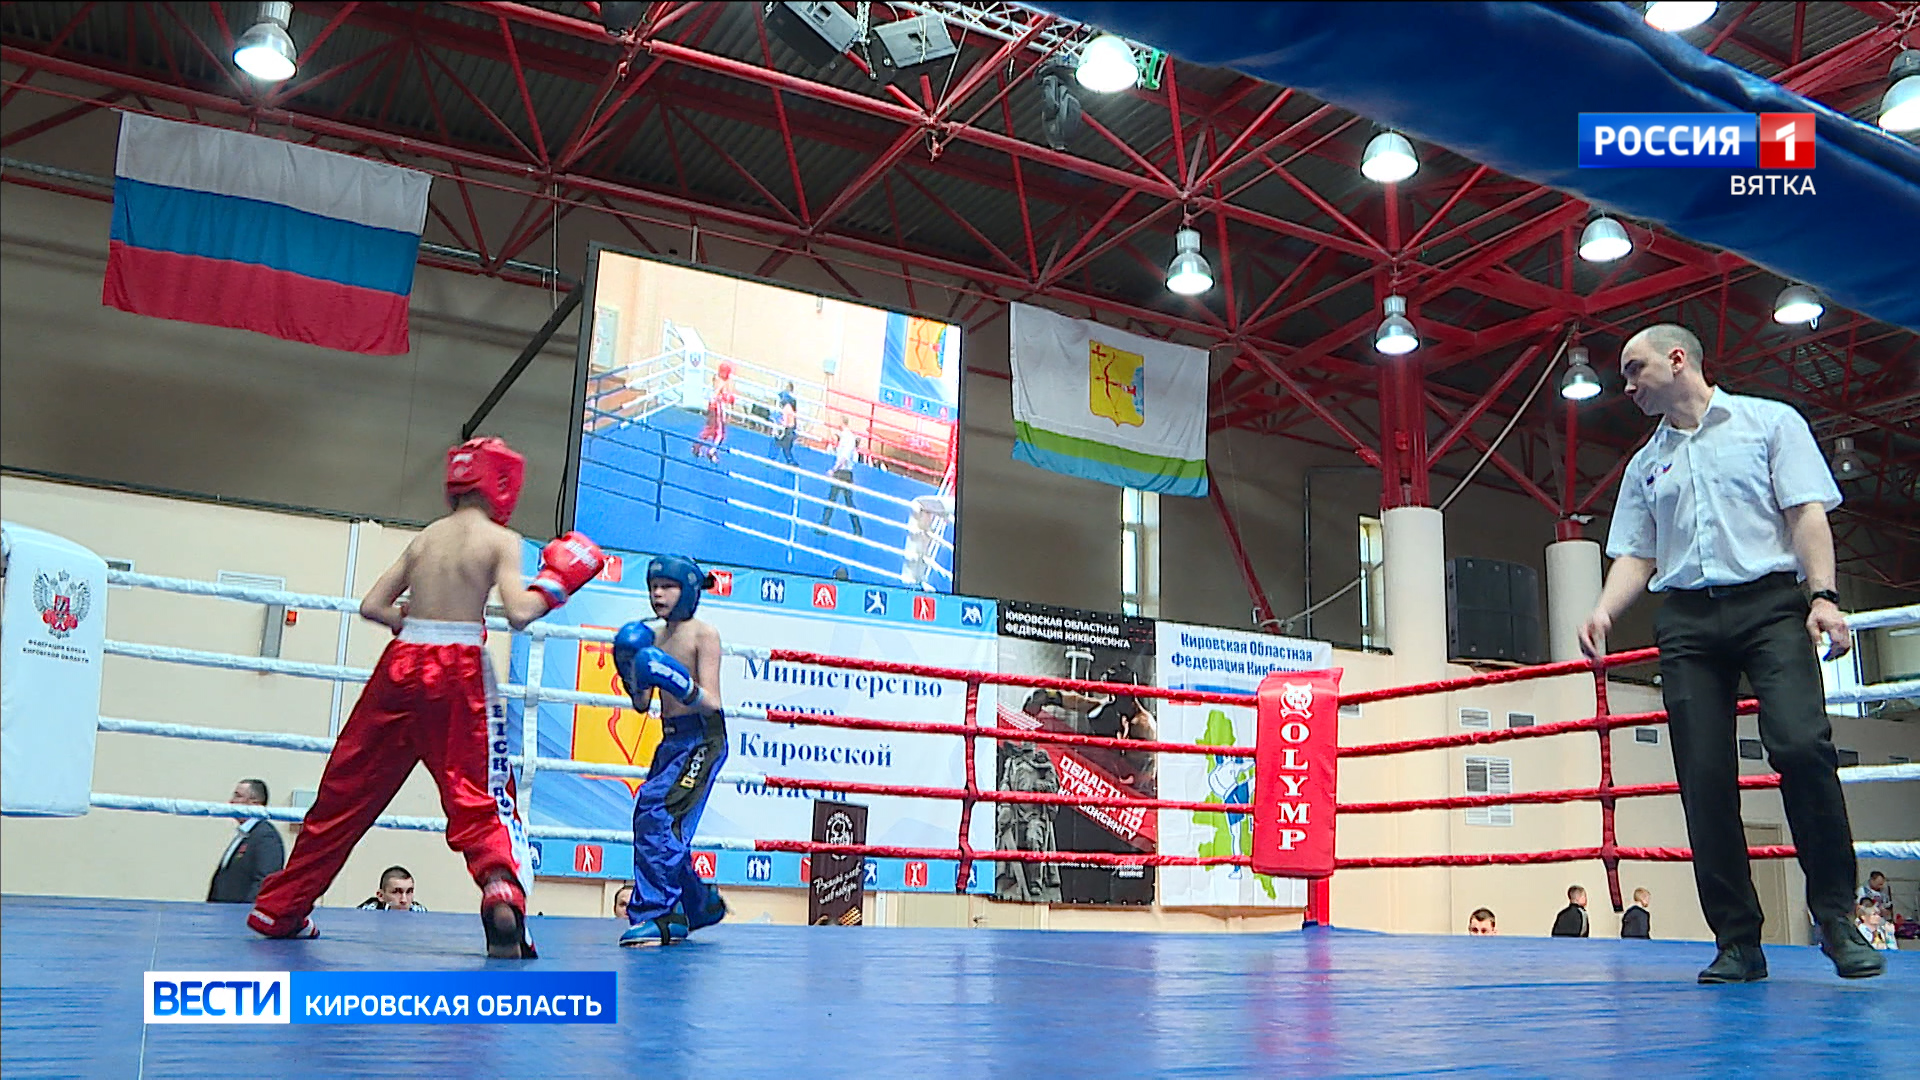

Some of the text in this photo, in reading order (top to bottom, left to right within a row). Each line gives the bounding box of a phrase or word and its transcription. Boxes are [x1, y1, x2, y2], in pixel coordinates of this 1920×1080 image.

[1005, 609, 1119, 636] КИРОВСКАЯ ОБЛАСТНАЯ
[1005, 622, 1131, 648] ФЕДЕРАЦИЯ КИКБОКСИНГА
[1181, 632, 1313, 662] Кировская Областная
[1171, 652, 1245, 674] Федерация
[743, 658, 942, 699] Министерство
[740, 732, 893, 768] Кировской
[1277, 722, 1311, 851] OLYMP
